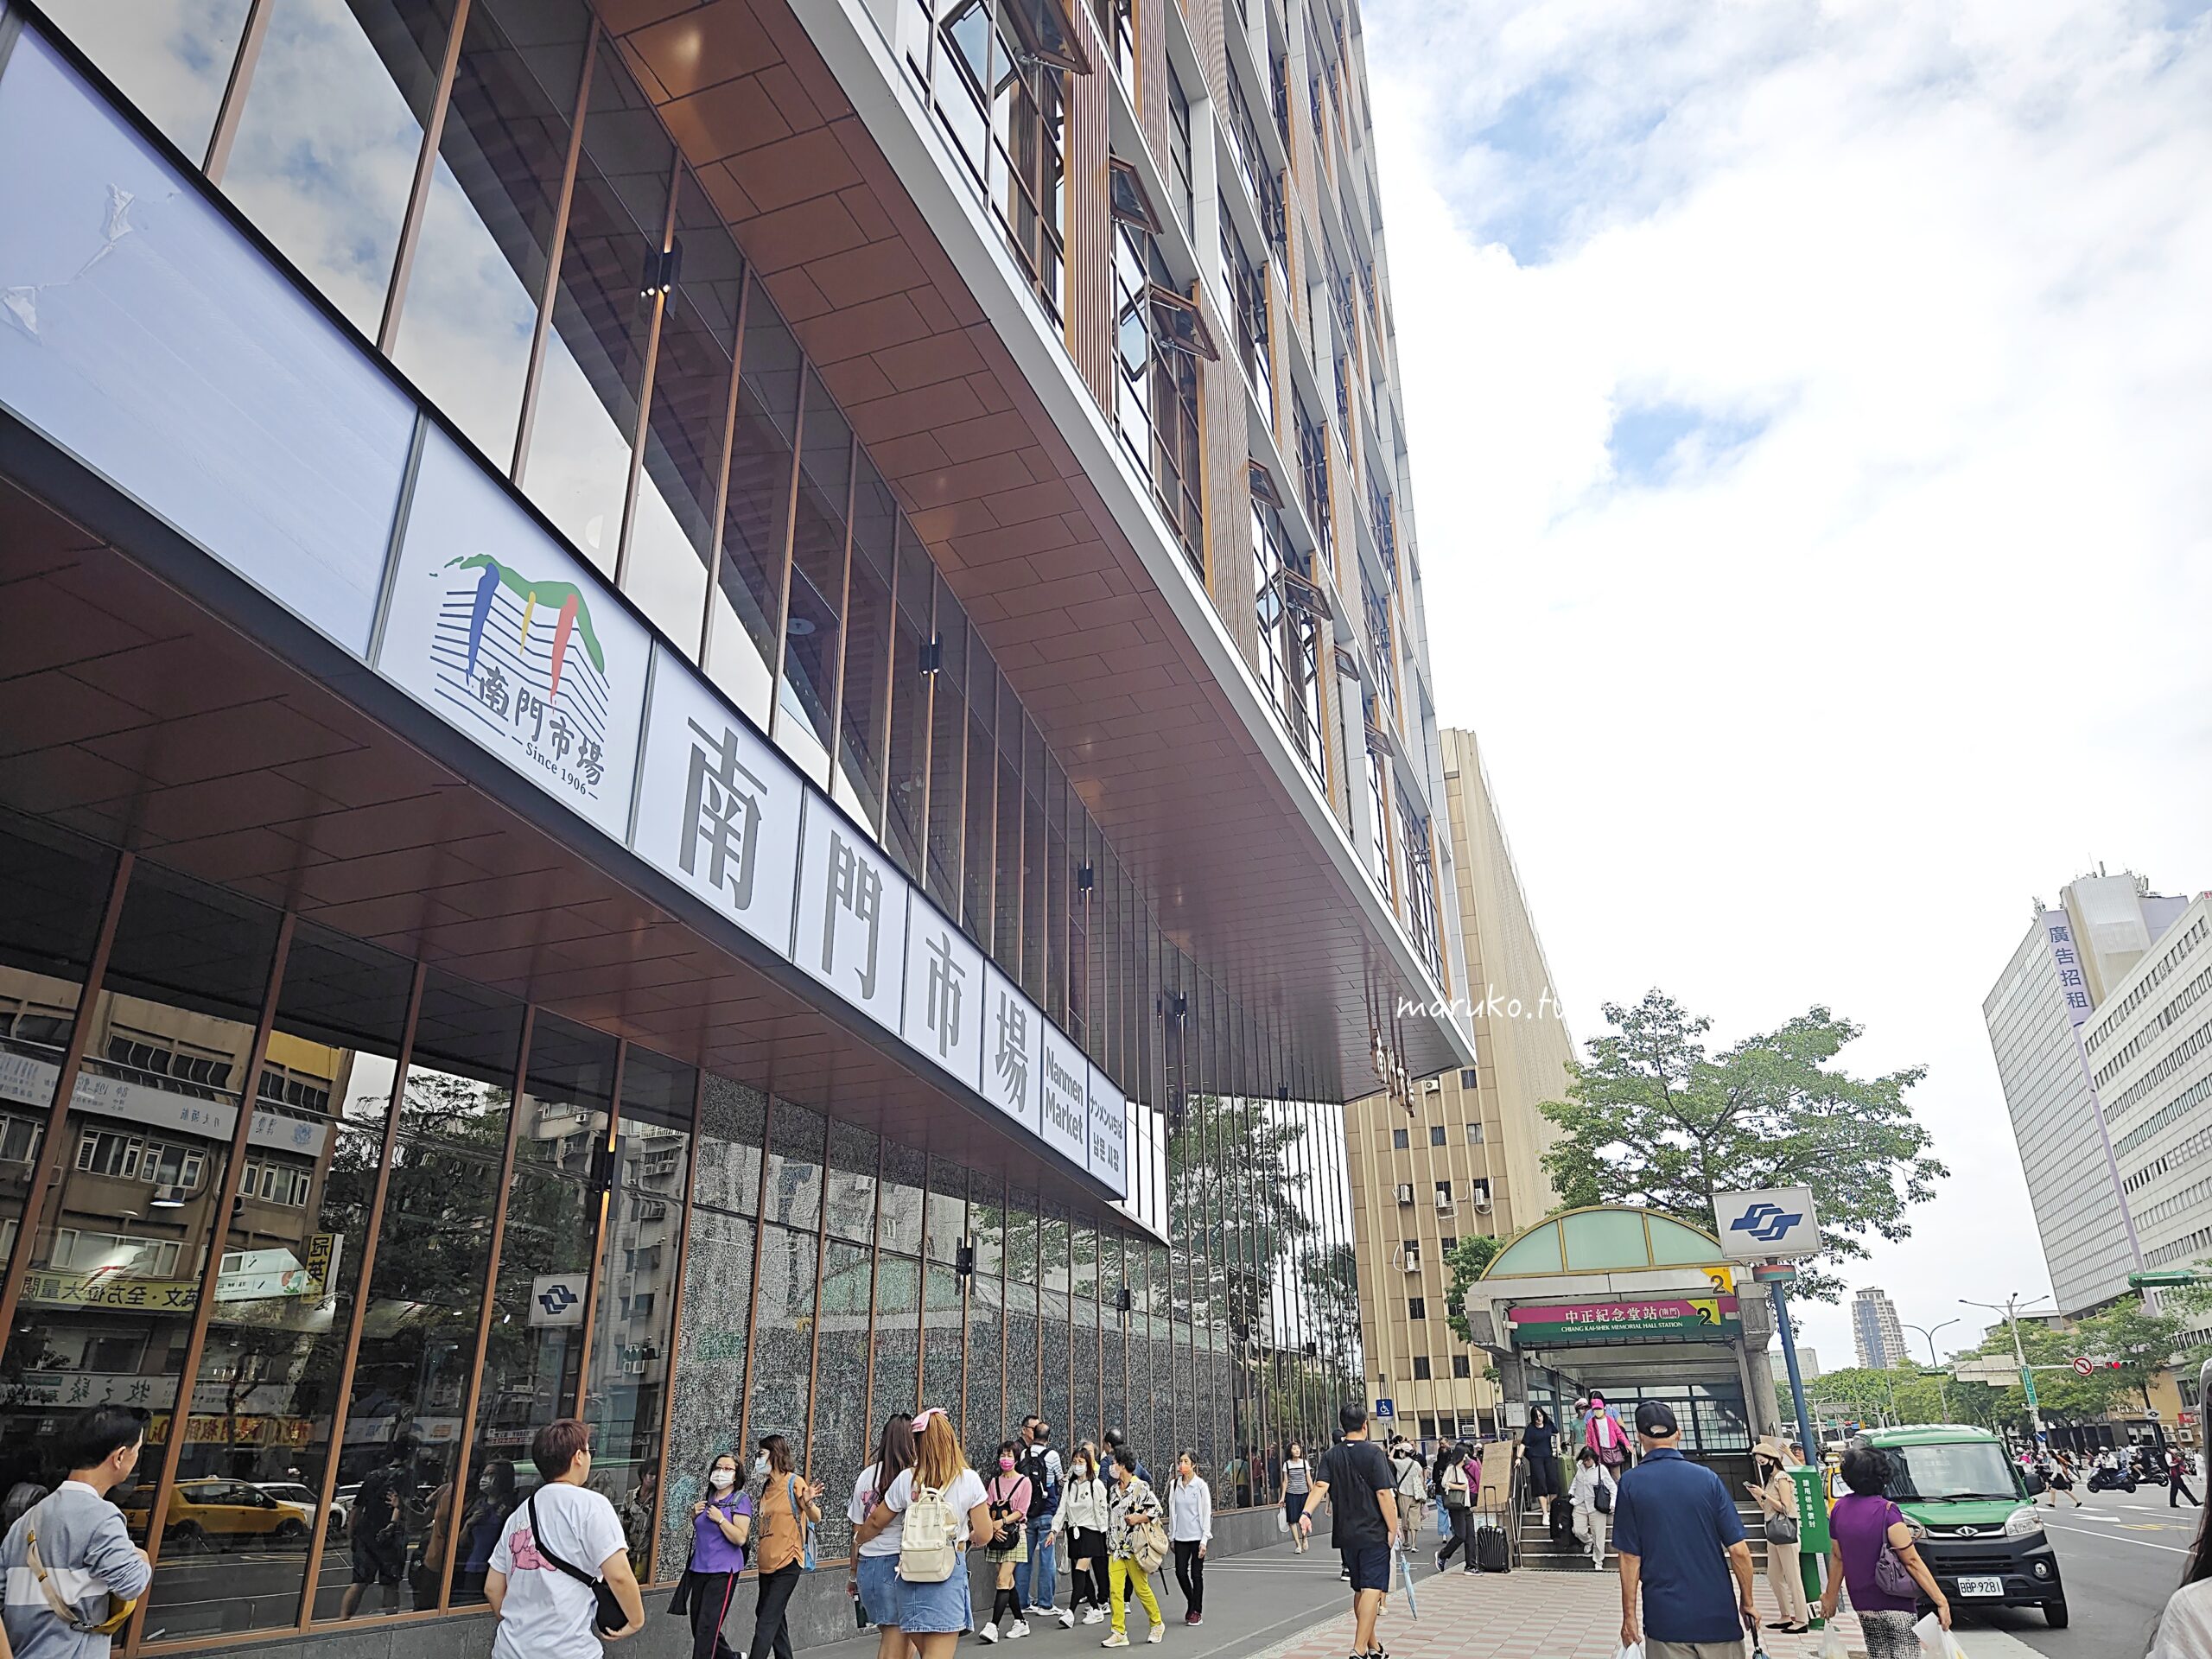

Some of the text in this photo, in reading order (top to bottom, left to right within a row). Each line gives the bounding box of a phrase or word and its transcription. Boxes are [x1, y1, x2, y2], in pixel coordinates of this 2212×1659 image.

[480, 666, 605, 785] 南門市場
[525, 742, 586, 795] Since 1906
[678, 715, 1028, 1114] 南門市場
[2049, 926, 2088, 1008] 廣告招租
[1046, 1046, 1084, 1107] Nanmen
[1046, 1086, 1084, 1145] Market
[1711, 1274, 1726, 1294] 2
[1565, 1306, 1657, 1325] 中正紀念堂站
[1696, 1306, 1714, 1326] 2
